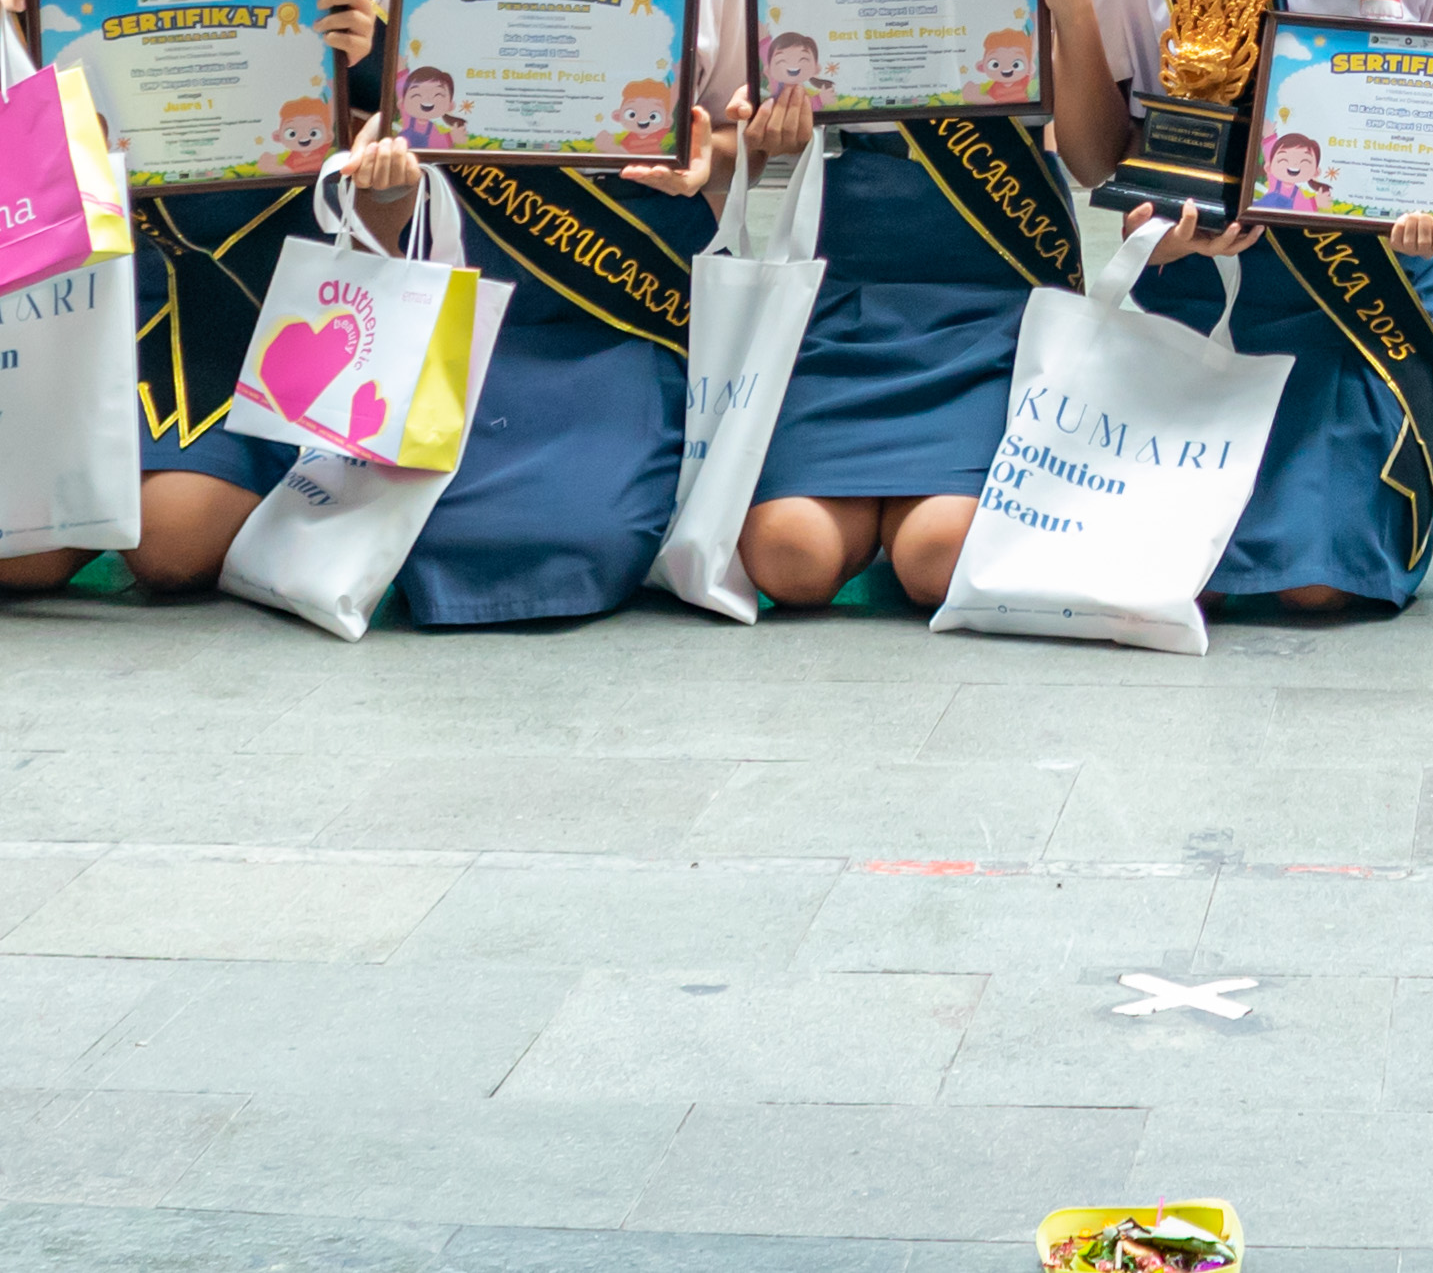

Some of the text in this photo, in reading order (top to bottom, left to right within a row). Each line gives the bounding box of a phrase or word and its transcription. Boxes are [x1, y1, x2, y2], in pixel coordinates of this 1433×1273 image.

[102, 5, 274, 40] SERTIFIKAT
[829, 26, 967, 41] Best Student Project
[466, 68, 606, 83] Best Student Project
[1328, 137, 1358, 149] Best
[1363, 140, 1413, 153] Student
[318, 279, 376, 371] authentic
[333, 317, 357, 355] beauty
[1357, 299, 1410, 361] 2025
[1015, 387, 1232, 469] KUMARI
[991, 462, 1033, 491] Of
[1001, 434, 1127, 495] Solution
